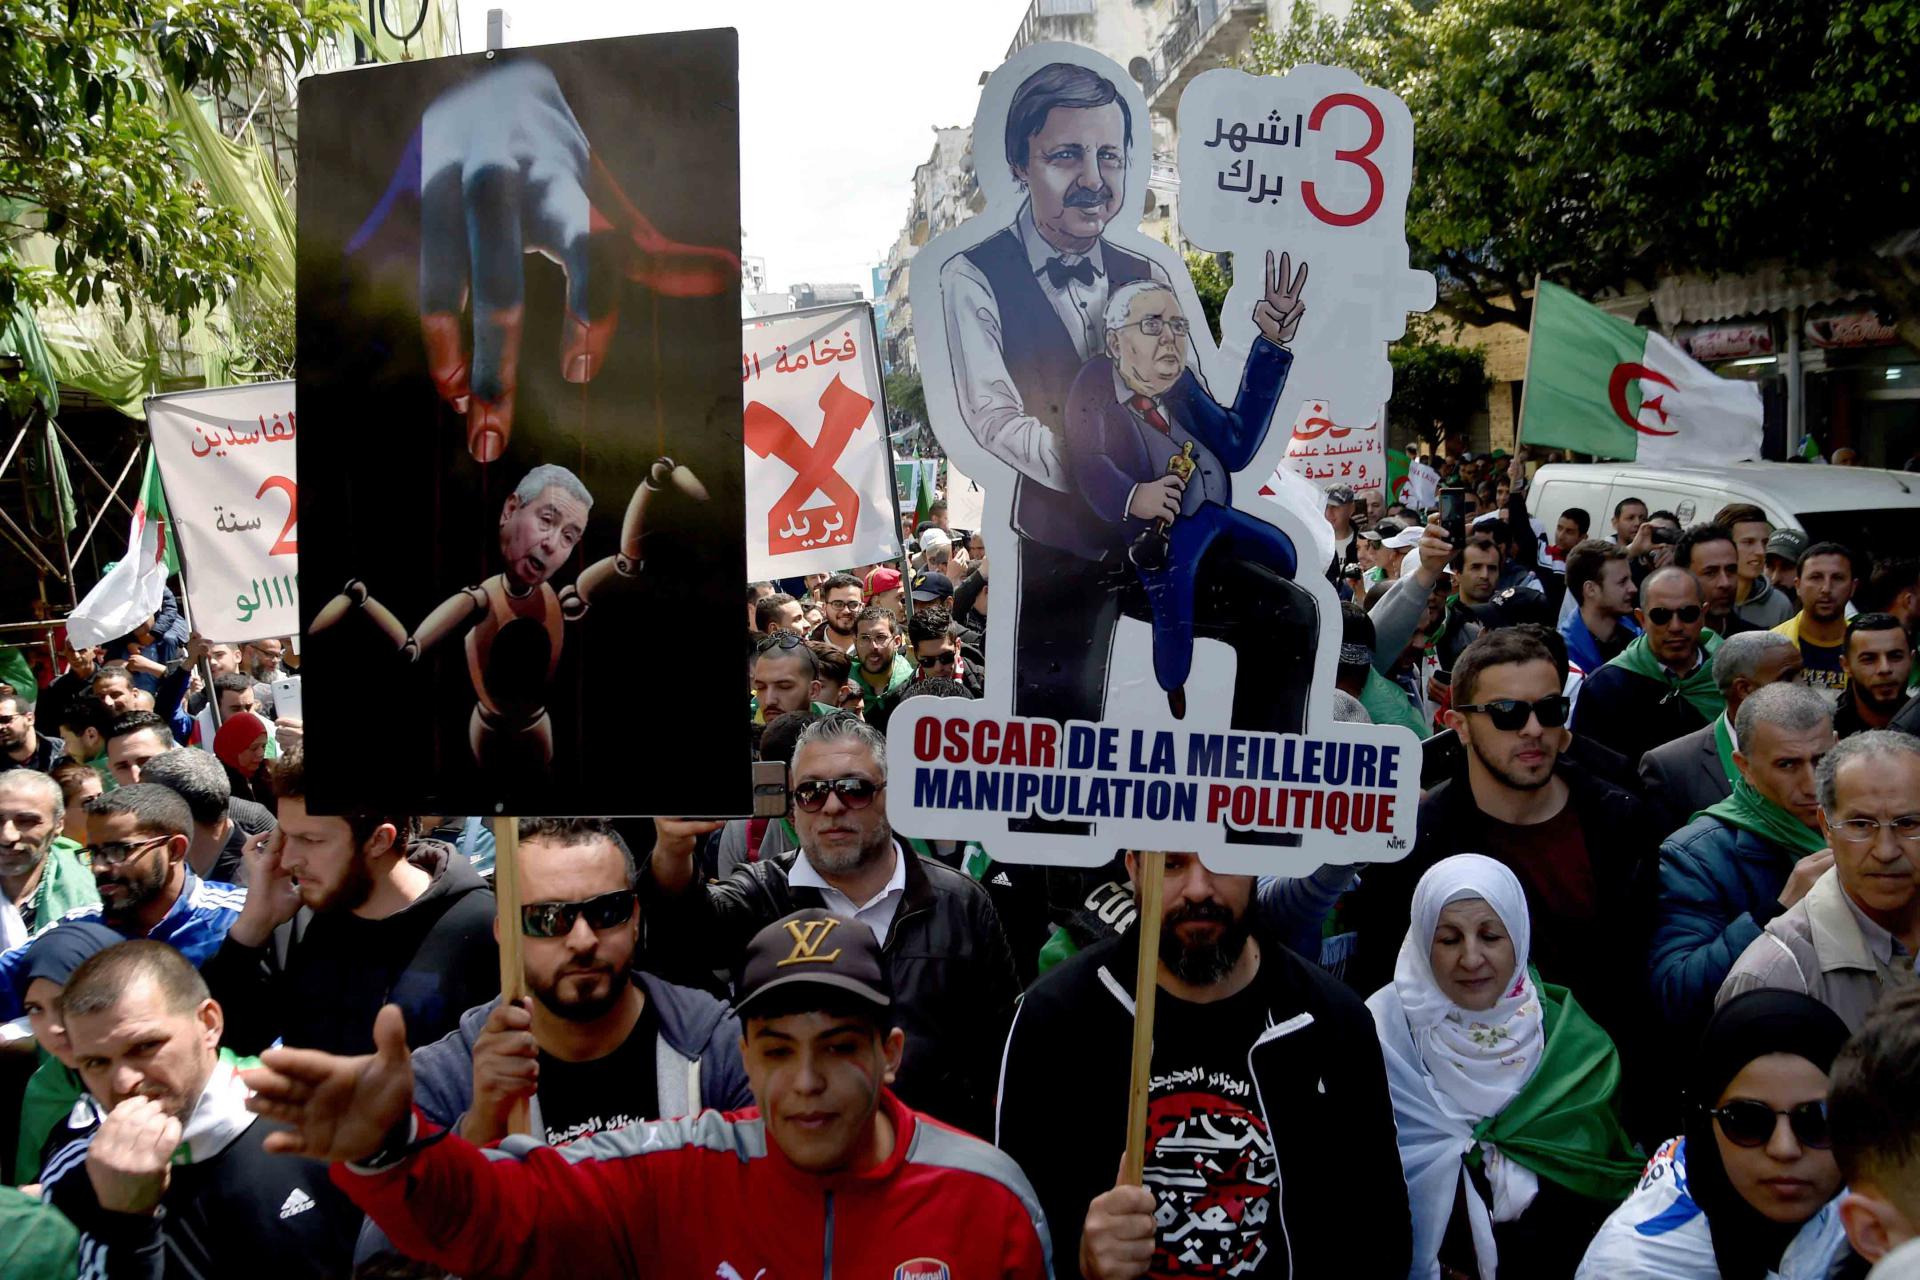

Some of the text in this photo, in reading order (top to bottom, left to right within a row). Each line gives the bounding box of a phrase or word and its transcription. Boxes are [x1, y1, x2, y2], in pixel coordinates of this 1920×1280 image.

[1203, 92, 1385, 227] 3 اشهر
[1217, 159, 1283, 205] برك
[775, 330, 857, 374] فخامة
[214, 505, 262, 533] سنة
[779, 509, 848, 547] يريد
[913, 716, 1400, 788] OSCAR DE LA MEILLEURE
[913, 767, 1396, 835] MANIPULATION POLITIQUE
